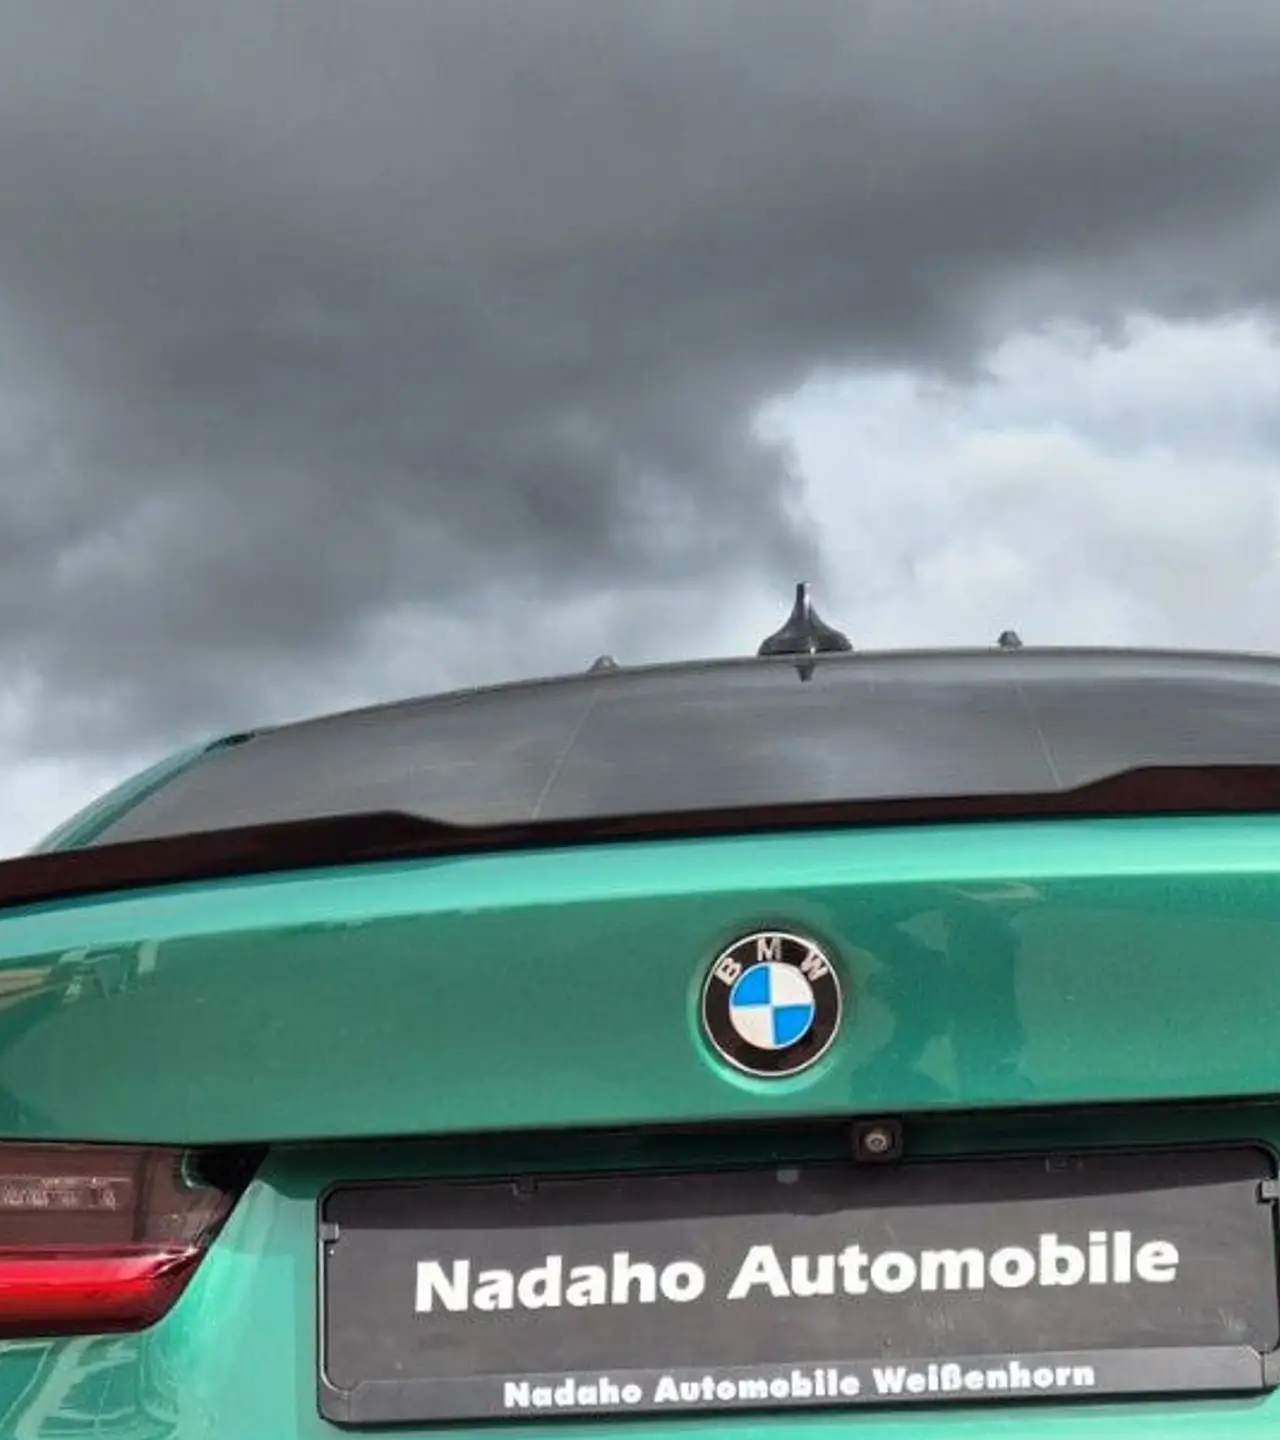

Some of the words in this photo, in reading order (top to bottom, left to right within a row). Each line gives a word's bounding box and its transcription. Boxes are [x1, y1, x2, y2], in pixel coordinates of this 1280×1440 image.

[714, 937, 829, 985] BMW
[415, 1252, 706, 1312] Nadaho
[727, 1230, 1180, 1300] Automobile
[504, 1381, 642, 1408] Nadaho
[653, 1369, 861, 1403] Automobile
[871, 1363, 1096, 1394] Weißenhorn
